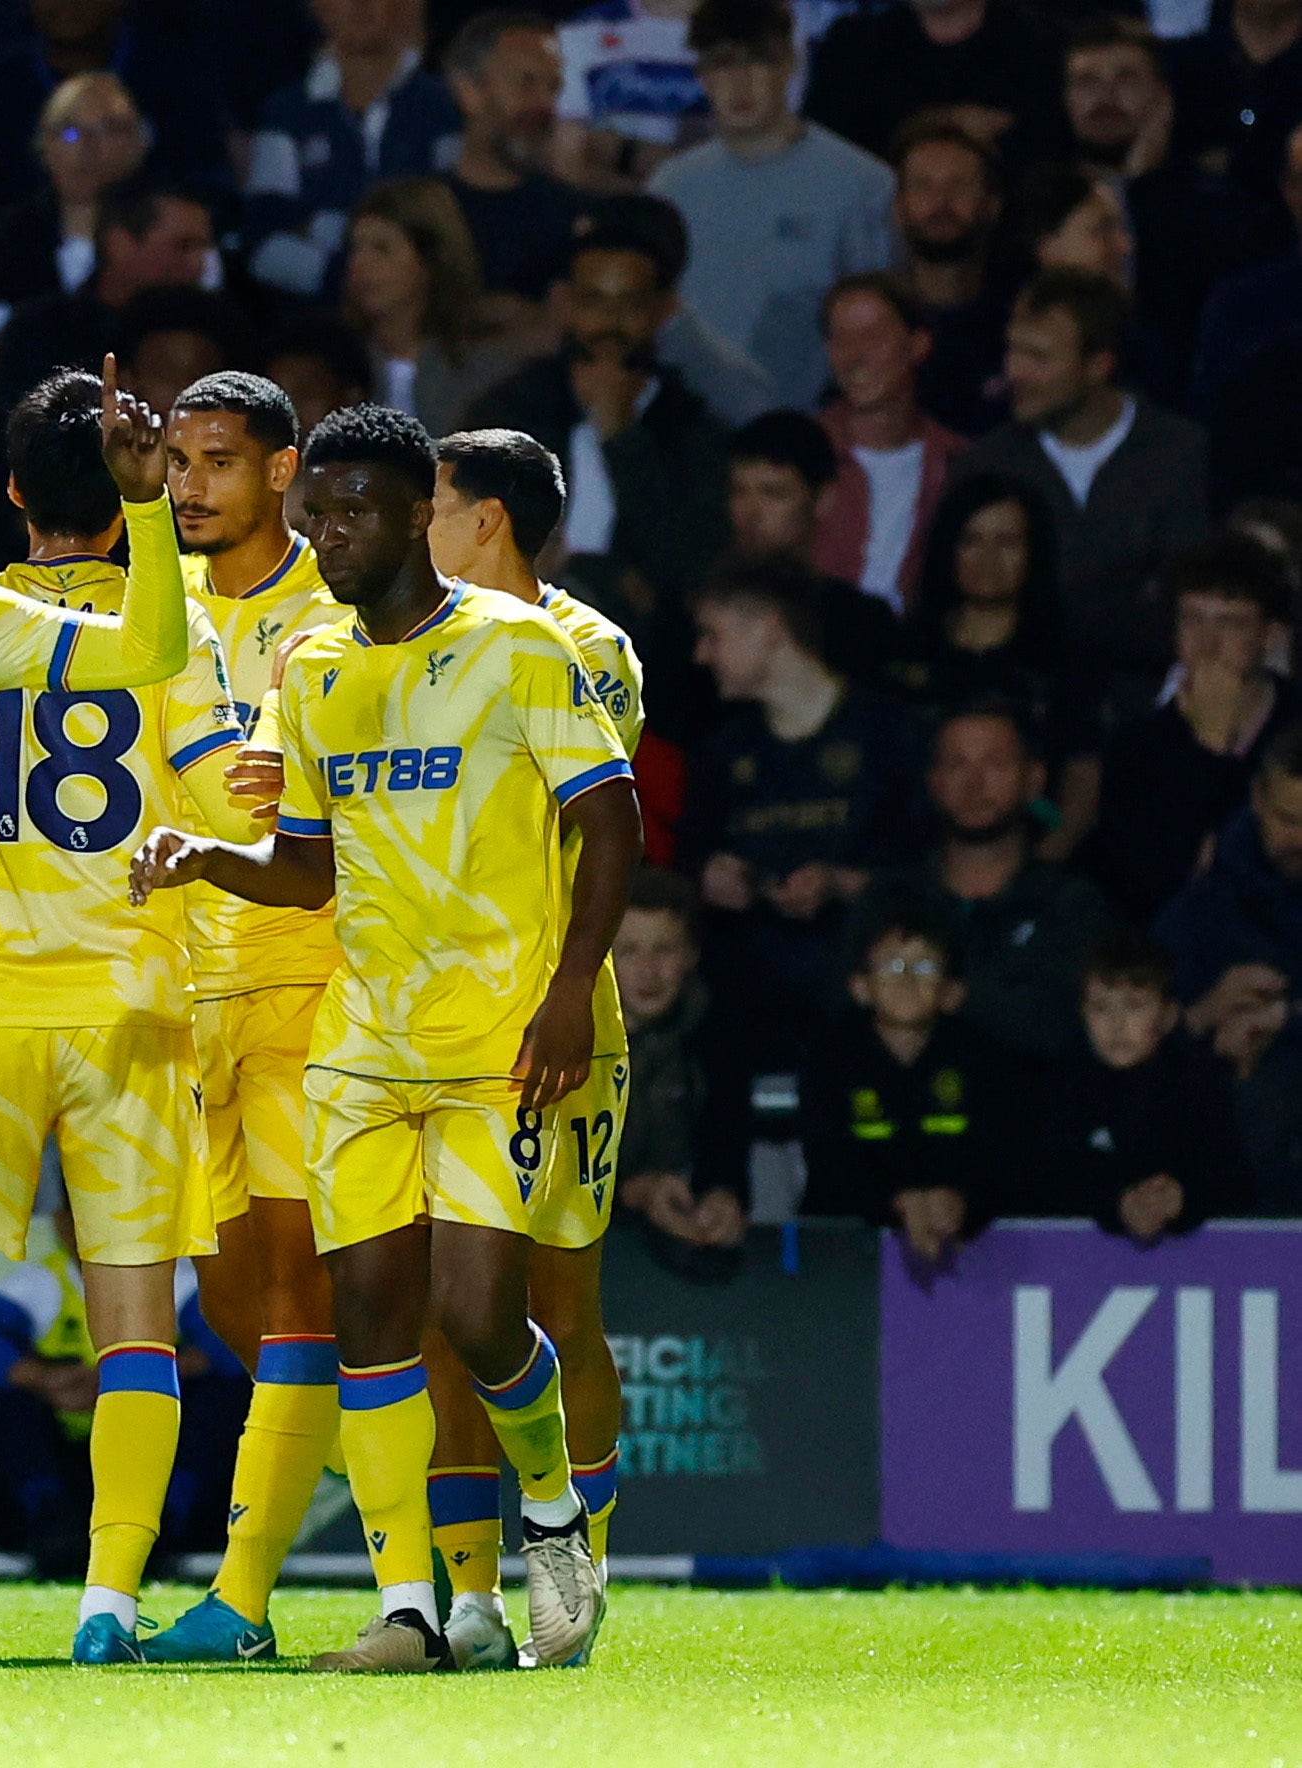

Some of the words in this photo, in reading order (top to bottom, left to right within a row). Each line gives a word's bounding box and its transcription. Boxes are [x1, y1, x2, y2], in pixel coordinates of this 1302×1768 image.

[318, 746, 463, 796] ET88
[510, 1105, 542, 1170] 8
[571, 1110, 613, 1185] 12
[1012, 1286, 1302, 1512] KIL
